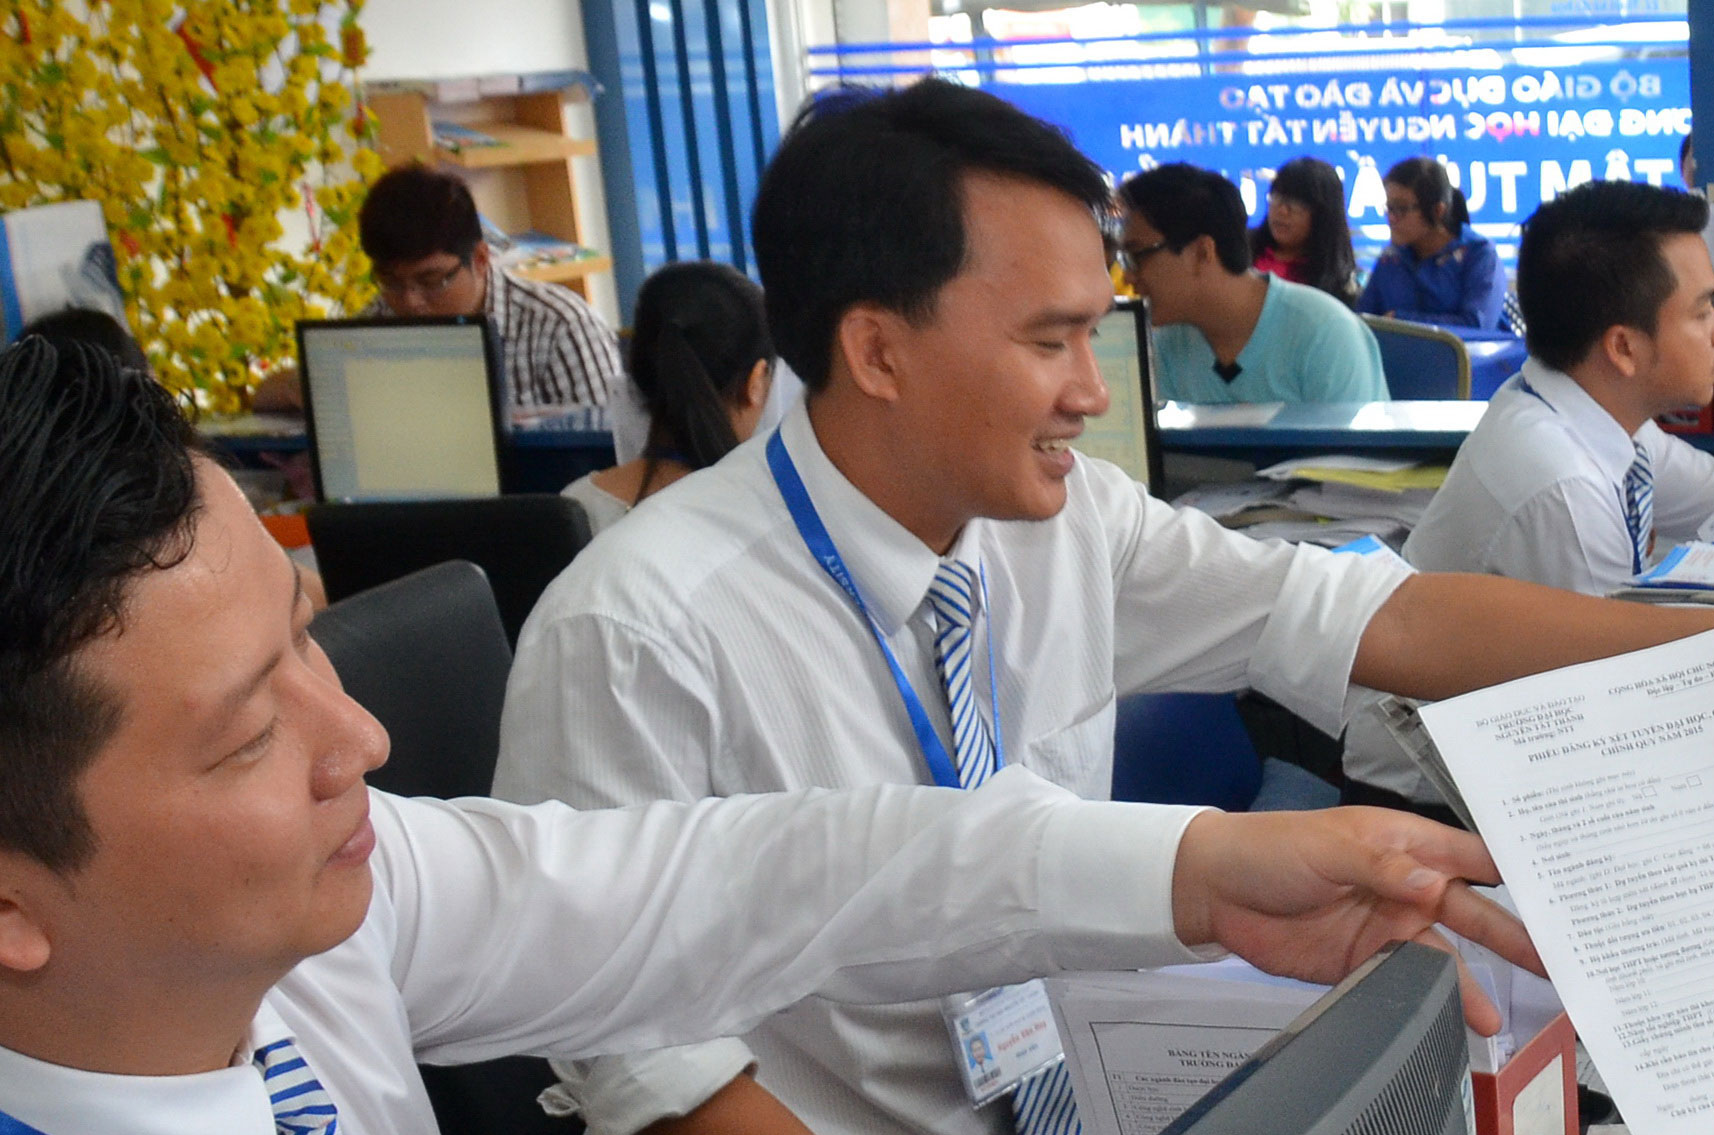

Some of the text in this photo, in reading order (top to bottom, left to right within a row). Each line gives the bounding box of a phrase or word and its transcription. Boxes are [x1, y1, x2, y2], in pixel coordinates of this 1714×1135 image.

[1606, 682, 1635, 696] CỘNG
[1632, 677, 1655, 690] HÒA
[1653, 673, 1669, 684] XÃ
[1666, 668, 1686, 680] HỘI
[1684, 662, 1705, 675] CHỦ
[1526, 747, 1560, 764] PHIẾU
[1560, 740, 1593, 756] ĐĂNG
[1590, 736, 1608, 748] KÝ
[1607, 731, 1630, 745] XÉT
[1629, 722, 1665, 739] TUYỂN
[1664, 717, 1685, 731] ĐẠI
[1684, 709, 1713, 725] HỌC,
[1599, 723, 1705, 758] CHÍNH QUY NĂM 2015
[1222, 1048, 1254, 1060] NGÀN
